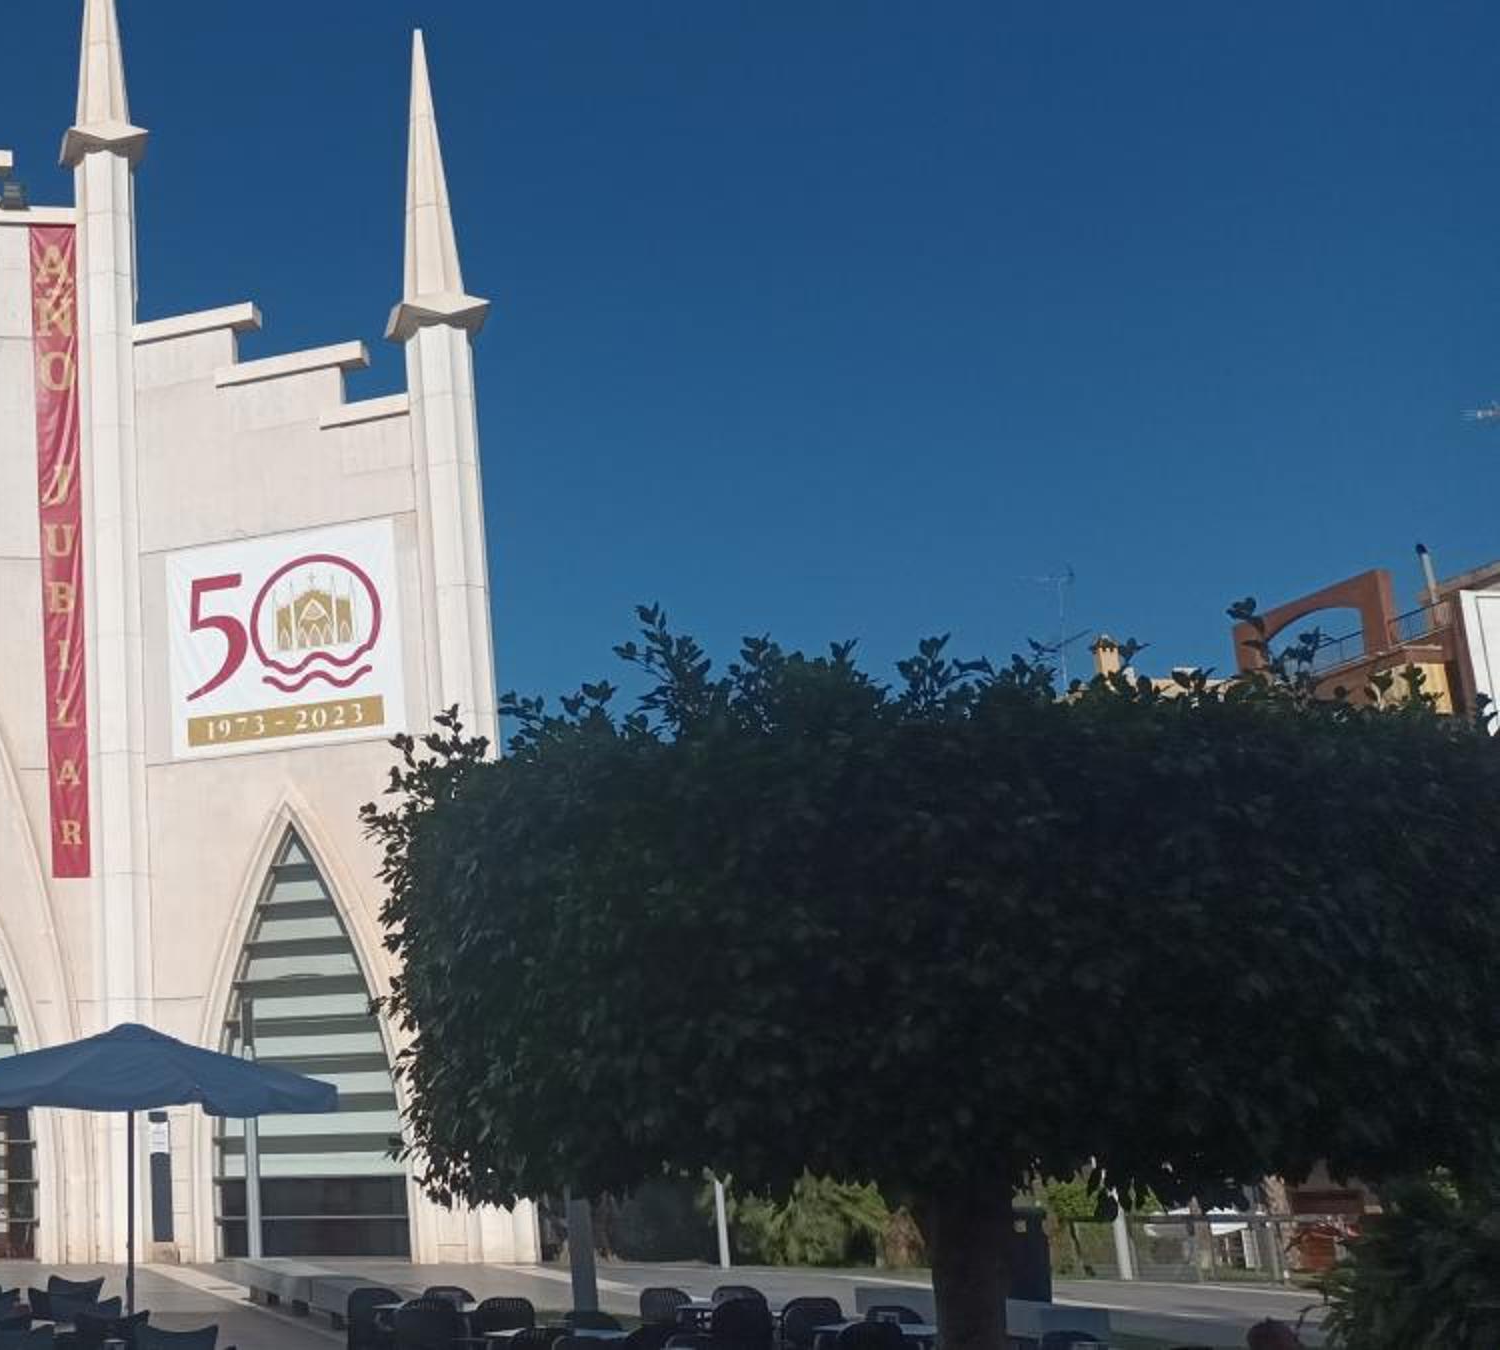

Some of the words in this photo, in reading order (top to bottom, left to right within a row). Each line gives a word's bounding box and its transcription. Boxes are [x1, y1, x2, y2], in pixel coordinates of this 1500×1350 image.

[35, 244, 75, 391] AÑO
[40, 465, 83, 844] JUBILAR
[206, 715, 266, 741] 1973
[297, 703, 365, 728] 2023
